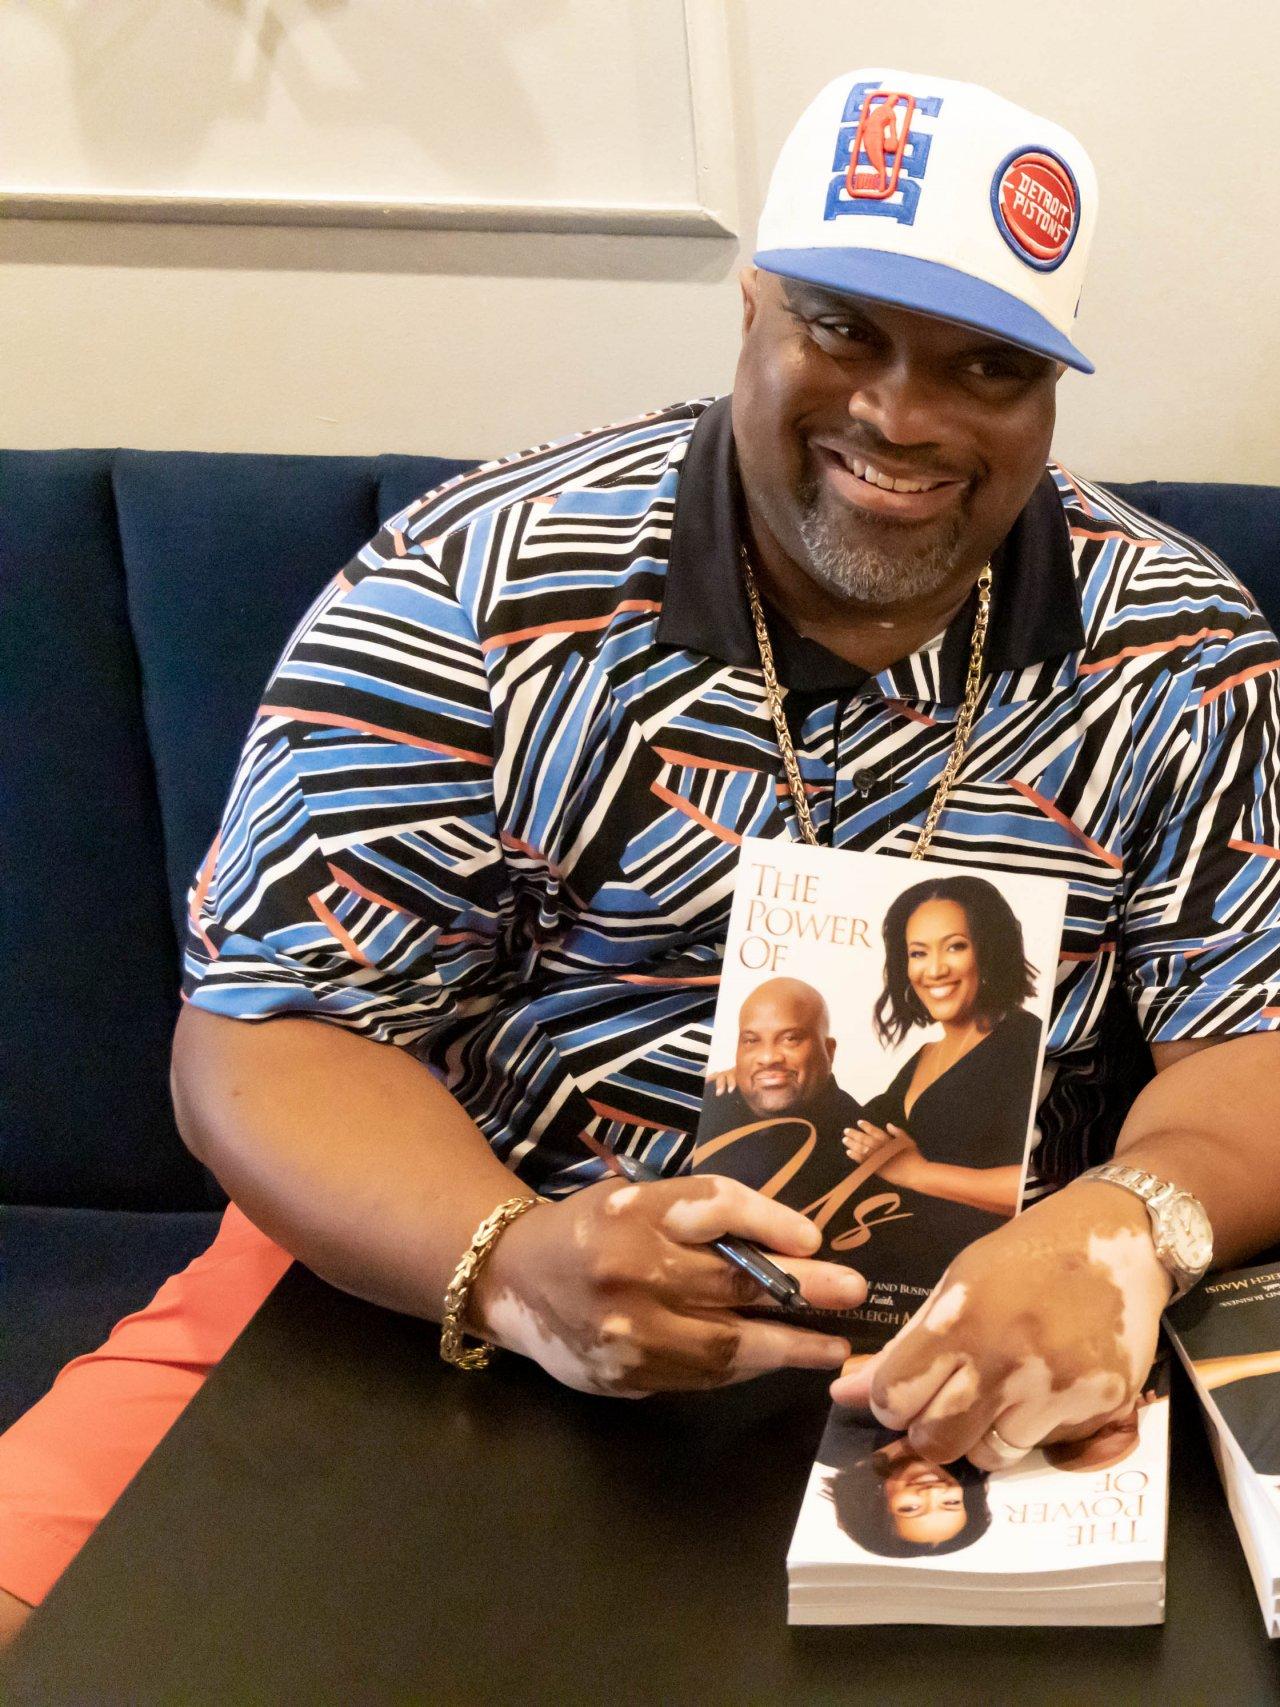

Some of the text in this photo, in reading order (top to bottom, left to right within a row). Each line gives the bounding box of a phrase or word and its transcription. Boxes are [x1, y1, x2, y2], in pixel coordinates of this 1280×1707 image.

[1018, 172, 1070, 224] DETROIT
[1013, 190, 1066, 242] PISTONS
[752, 864, 820, 904] THE
[746, 900, 873, 948] POWER
[739, 936, 788, 971] OF
[900, 1284, 934, 1296] BUSIN
[1094, 1470, 1149, 1494] OF
[1004, 1494, 1144, 1523] POWER
[1066, 1520, 1147, 1546] THE
